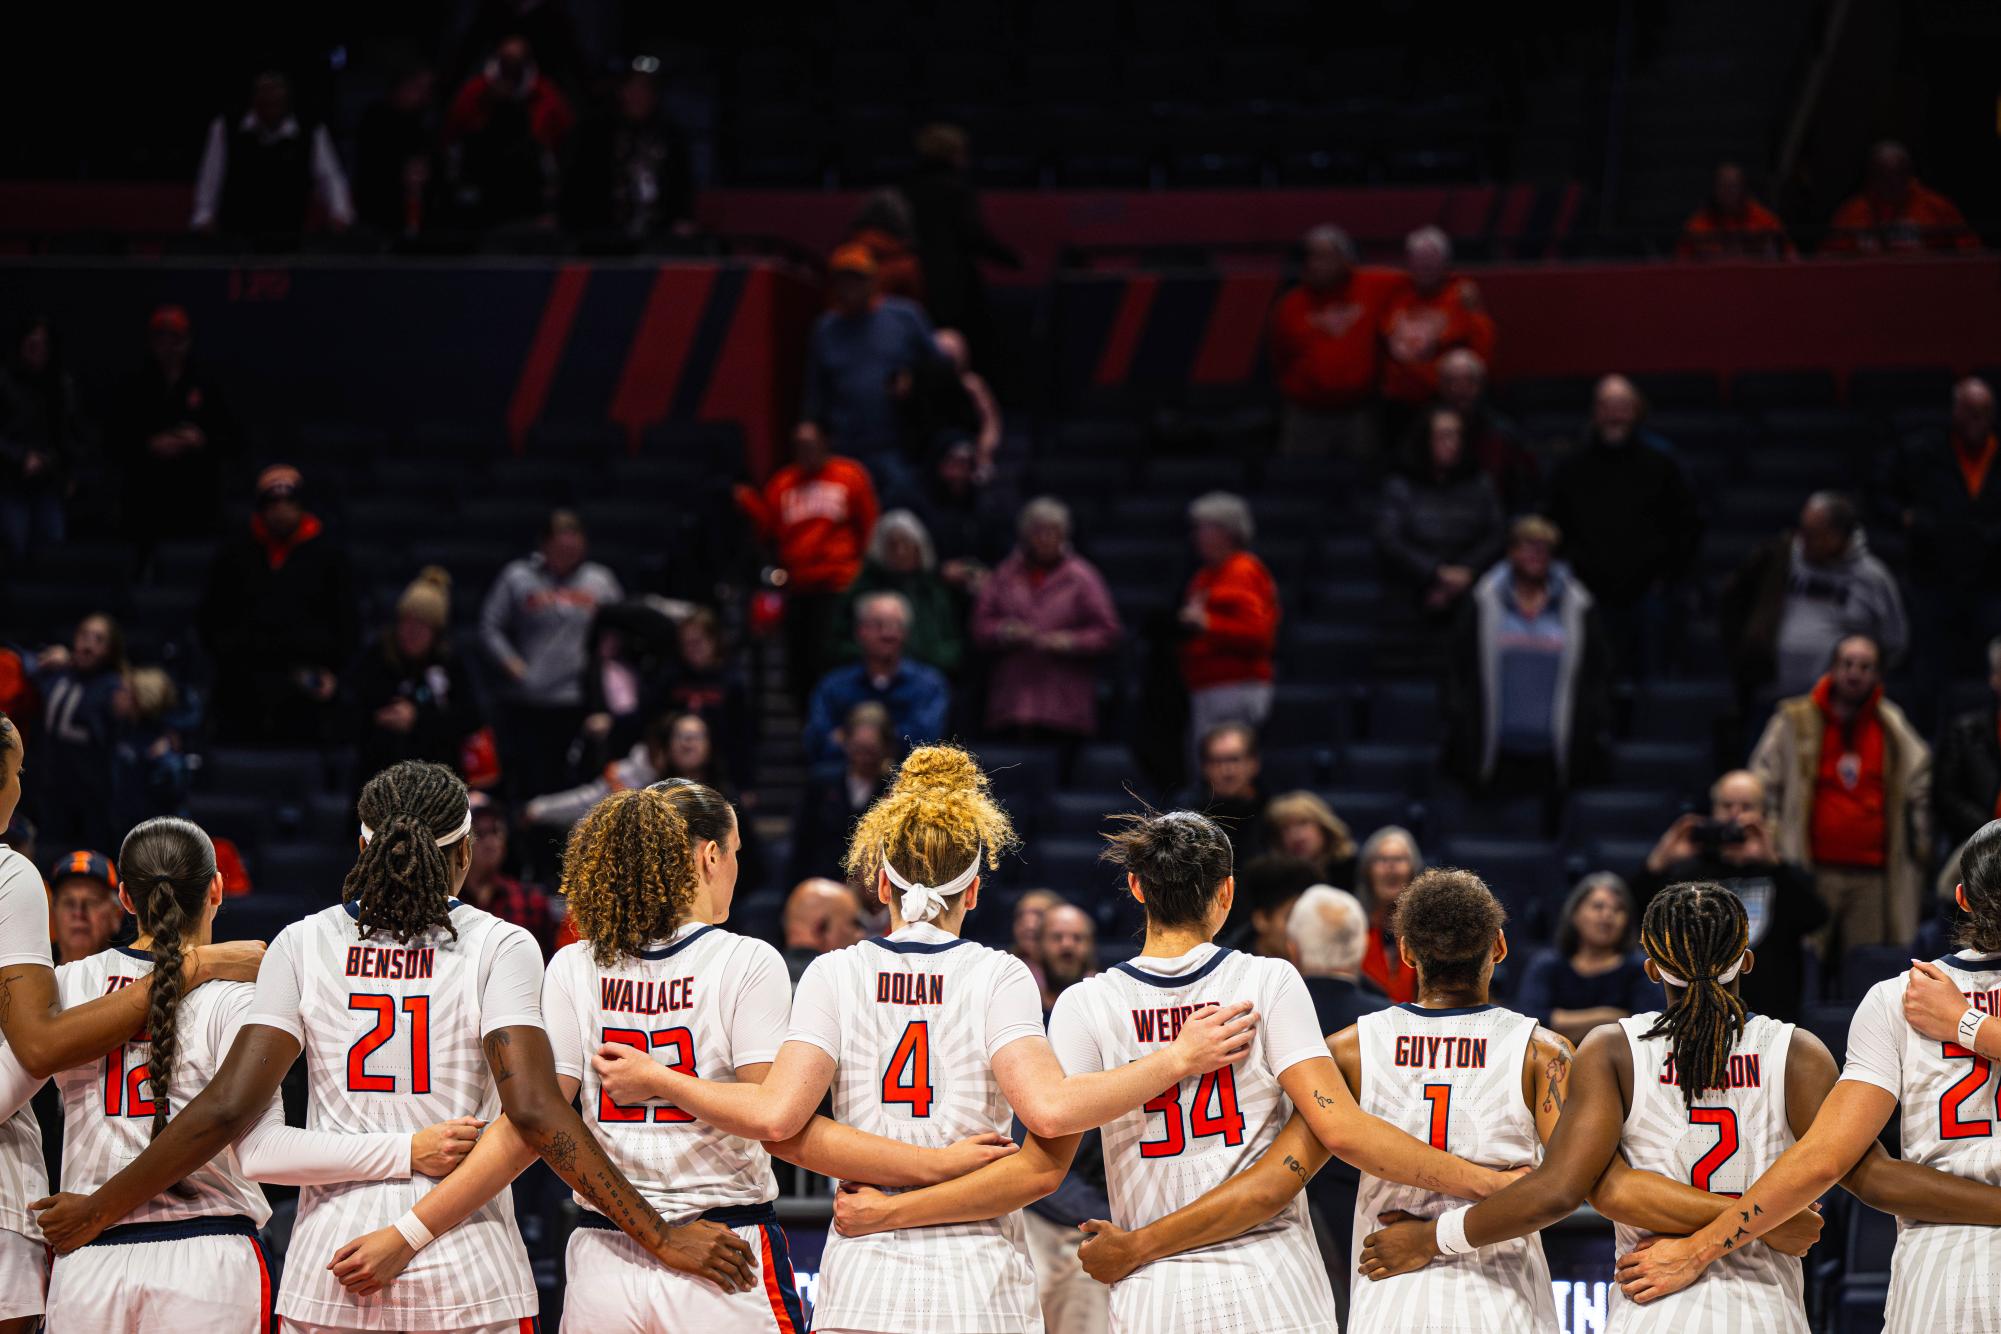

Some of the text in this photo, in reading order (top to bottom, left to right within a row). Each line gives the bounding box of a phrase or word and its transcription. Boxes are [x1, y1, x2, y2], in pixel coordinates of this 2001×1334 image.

[345, 946, 434, 980] BENSON
[877, 972, 944, 1006] DOLAN
[600, 975, 695, 1016] WALLACE
[347, 992, 431, 1094] 21
[881, 1021, 934, 1118] 4
[1394, 1035, 1488, 1070] GUYTON
[1423, 1083, 1453, 1153] 1
[1688, 1106, 1740, 1200] 2
